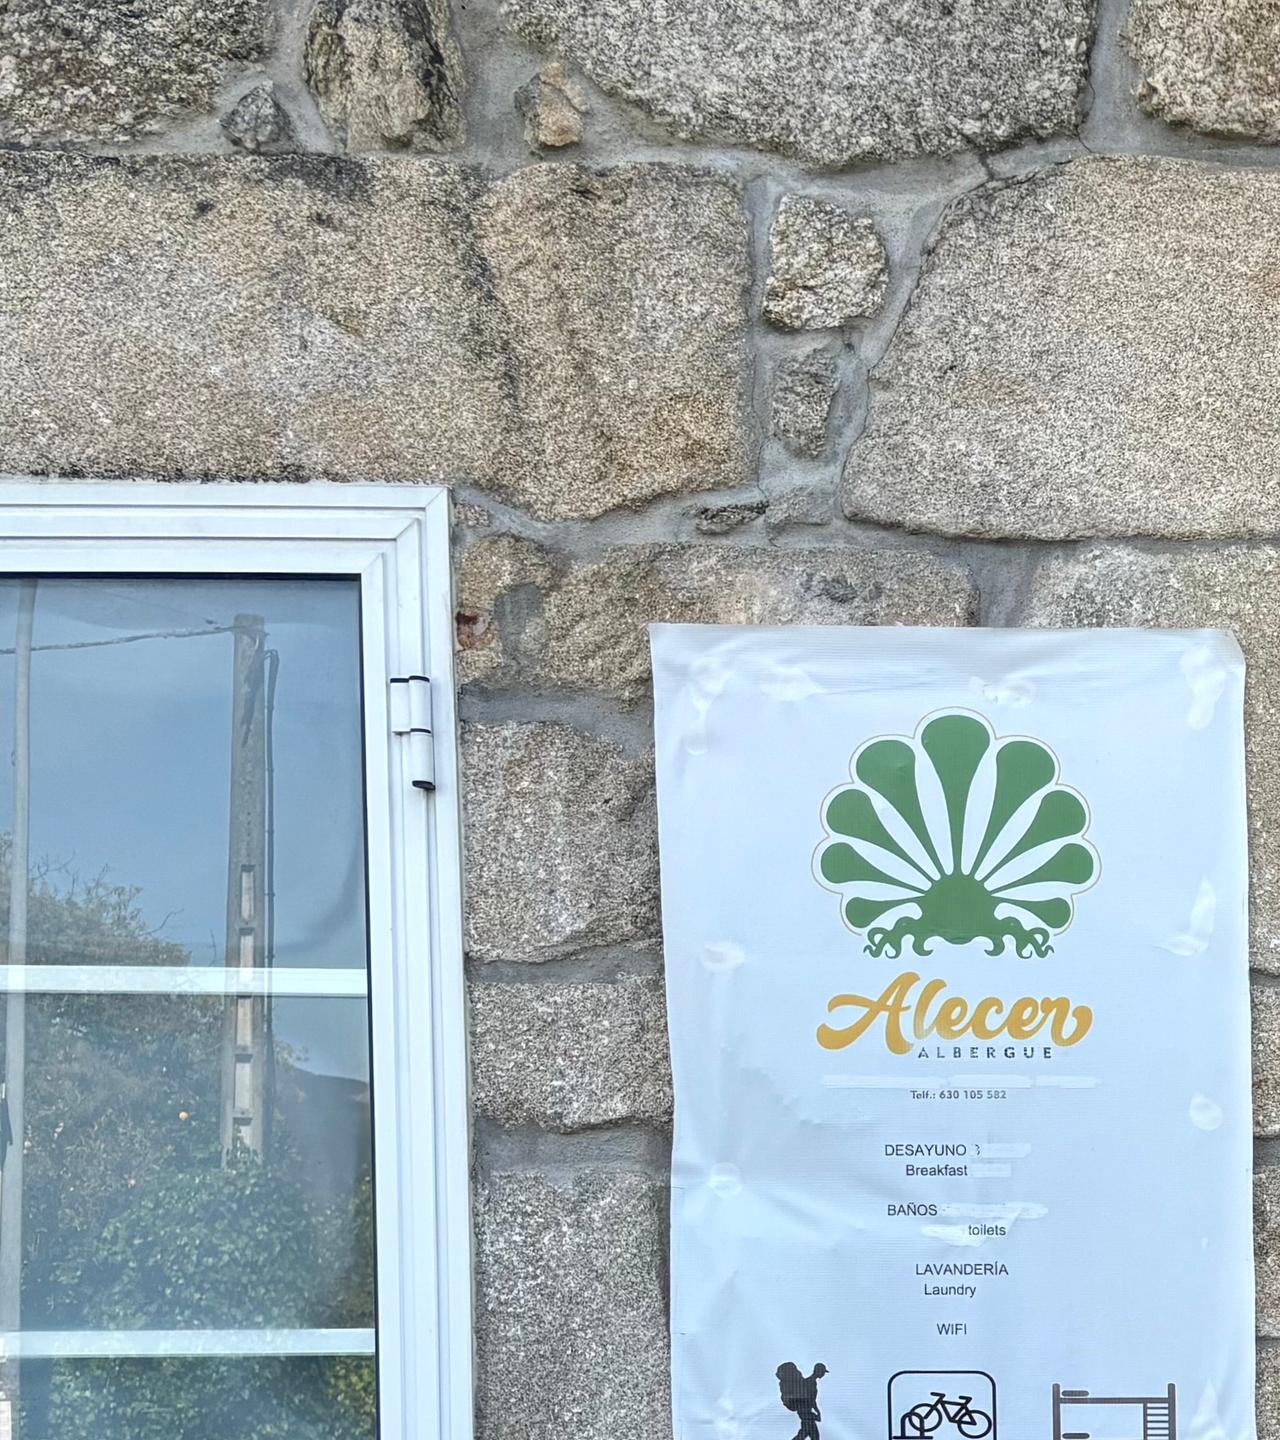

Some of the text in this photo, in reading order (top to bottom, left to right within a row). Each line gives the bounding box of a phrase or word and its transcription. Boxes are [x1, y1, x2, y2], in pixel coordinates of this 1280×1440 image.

[816, 971, 1093, 1055] Alecer
[918, 1046, 1053, 1059] ALBERGUE
[939, 1090, 960, 1100] 630
[964, 1090, 983, 1100] 105
[986, 1090, 1007, 1100] 582
[885, 1144, 967, 1156] DESAYUNO
[906, 1164, 968, 1176] Breakfast
[888, 1202, 938, 1216] BAÑOS
[968, 1224, 1006, 1236] toilets
[916, 1260, 1009, 1277] LAVANDERÍA
[924, 1283, 977, 1298] Laundry
[937, 1322, 968, 1336] WIFI
